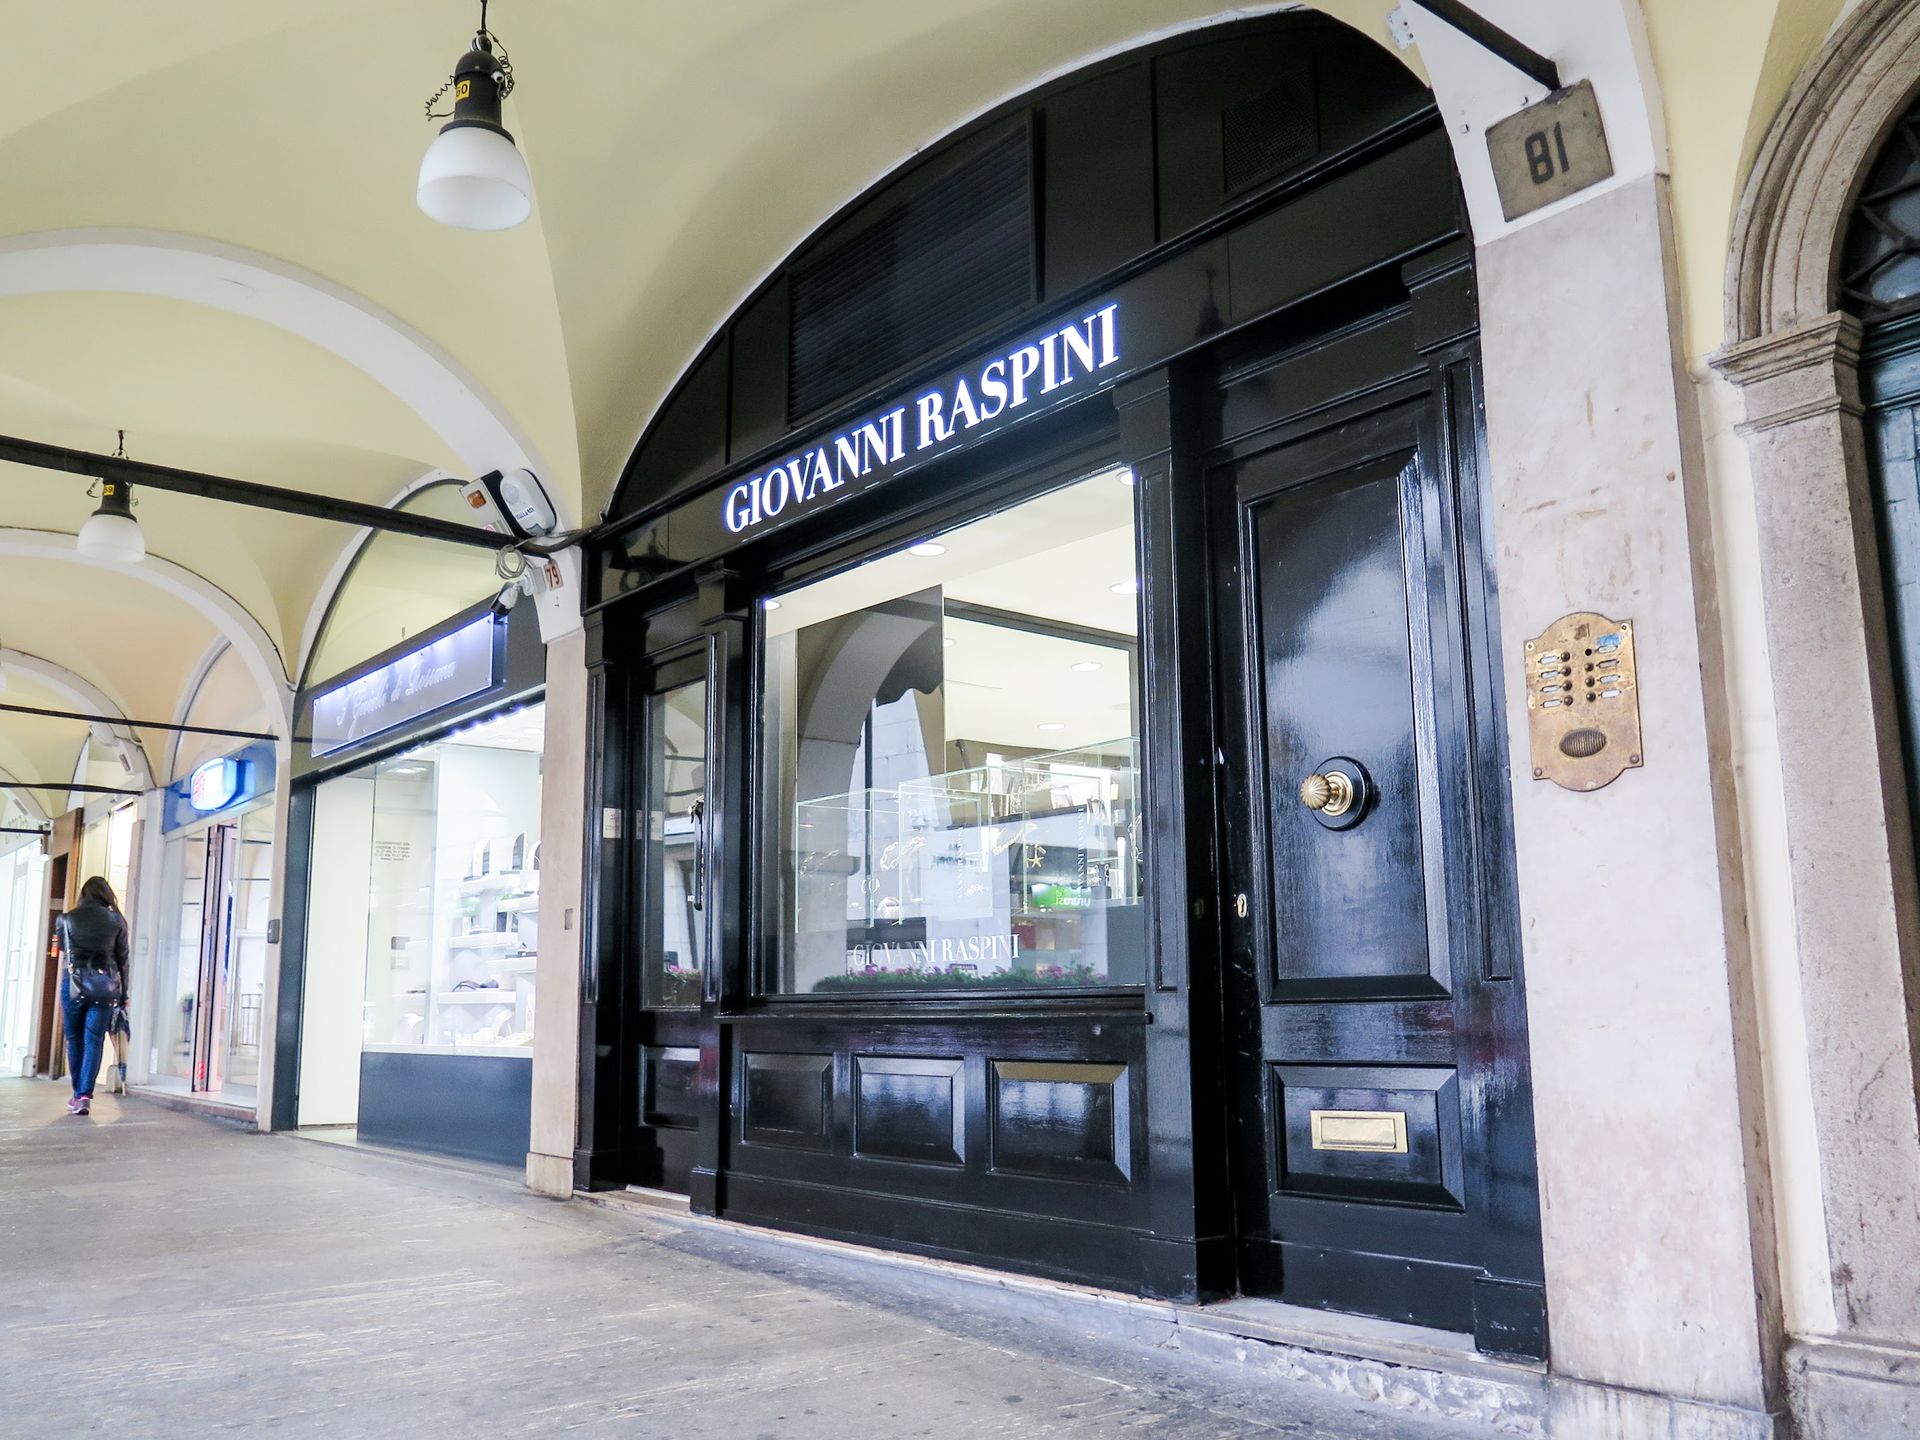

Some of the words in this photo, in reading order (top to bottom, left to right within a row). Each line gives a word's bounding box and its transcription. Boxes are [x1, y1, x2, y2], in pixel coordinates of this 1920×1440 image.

[1524, 120, 1570, 184] 81
[726, 407, 906, 533] GIOVANNI
[916, 303, 1120, 450] RASPINI
[545, 565, 560, 588] 79
[853, 938, 936, 967] GIOVANNI
[941, 933, 1020, 962] RASPINI
